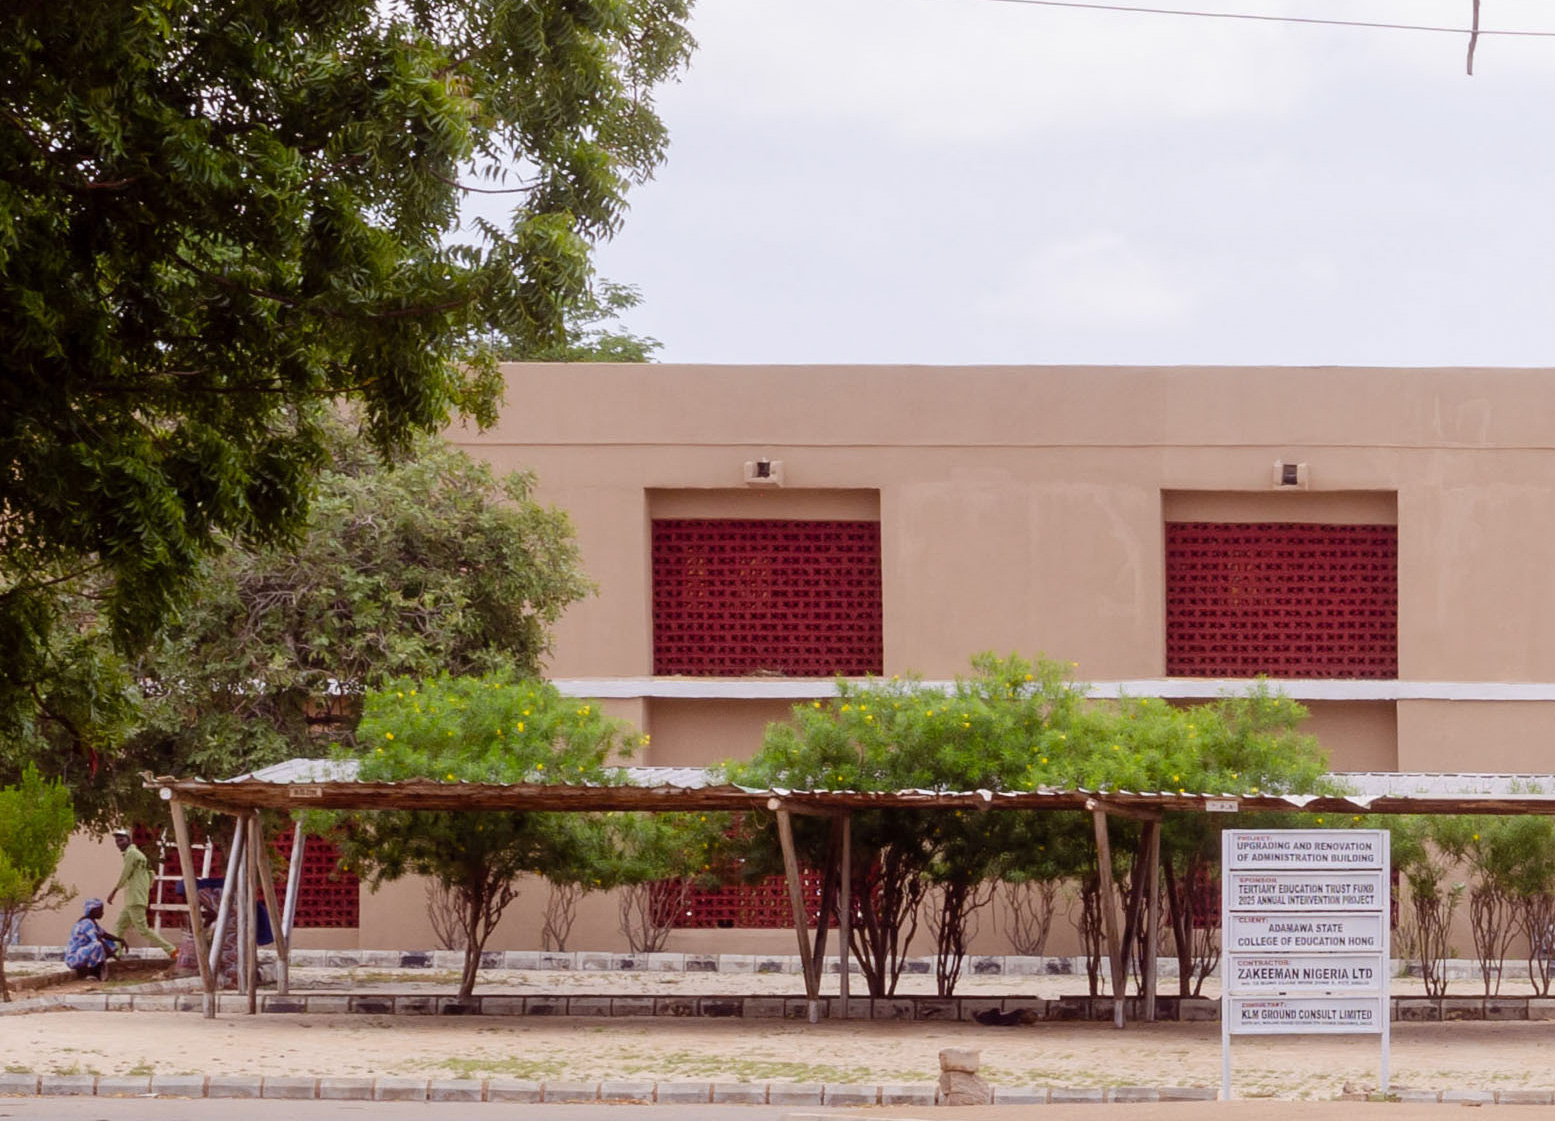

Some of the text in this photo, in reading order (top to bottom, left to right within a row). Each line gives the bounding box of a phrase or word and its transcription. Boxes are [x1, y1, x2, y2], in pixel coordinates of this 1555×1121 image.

[1237, 842, 1372, 850] UPGRADING AND RENOVATION
[1237, 853, 1374, 863] OF ADMINISTRATION BUILDING
[1238, 884, 1374, 894] TERTIARY EDUCATION TRUST FUND
[1257, 896, 1286, 905] ANNUAL
[1288, 895, 1340, 905] INTERVENTION
[1342, 895, 1374, 905] PROJECT
[1268, 924, 1343, 932] ADAMAWA STATE
[1238, 937, 1374, 946] COLLEGE OF EDUCATION HONG
[1238, 968, 1373, 979] ZAKEEMAN NIGERIA LTD
[1241, 1009, 1373, 1020] KLM GROUND CONSULT LIMITED
